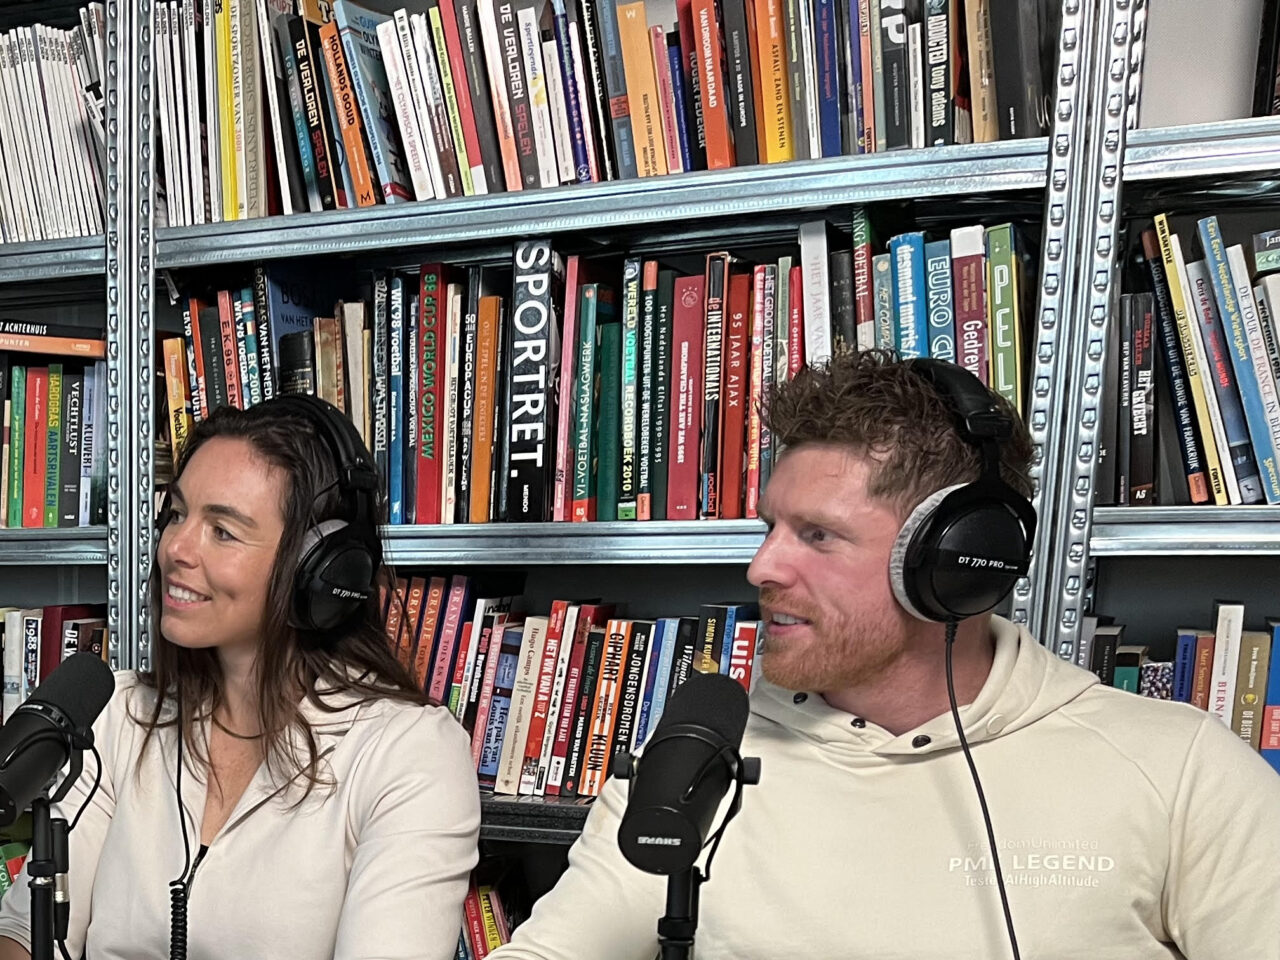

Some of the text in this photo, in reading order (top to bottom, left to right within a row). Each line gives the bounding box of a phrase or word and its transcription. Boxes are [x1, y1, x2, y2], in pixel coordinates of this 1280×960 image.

[296, 39, 308, 59] DE
[700, 8, 717, 108] VAN DROOM NAAR DAAD
[927, 14, 948, 127] ADDICTED tony adams
[299, 60, 320, 128] VERLOREN
[329, 34, 355, 126] HOLLANDS GOUD
[499, 4, 532, 156] DE VERLOREN SPELEN
[689, 52, 706, 149] ROGER FEDERER
[312, 129, 330, 179] SPELEN
[854, 243, 868, 299] VOETBAL
[391, 330, 402, 375] voetbal
[762, 275, 774, 379] HET GROOT VOETBAL
[247, 352, 260, 404] EK 2000
[421, 273, 437, 459] MEXICO WORLD CUP 86
[463, 333, 474, 418] EUROPACUP
[510, 242, 551, 478] SPORTRET.
[622, 280, 638, 491] WERELD VOETBAL RECORDBOEK 2010
[728, 313, 742, 407] 95 JAAR AJAX
[1137, 370, 1152, 389] HET
[1239, 286, 1280, 450] DE TOUR DE FRANCE IN BEELD
[70, 381, 80, 455] VECHTLUST
[576, 341, 593, 497] VI-VOETBAL-NASLAGWERK
[639, 295, 653, 489] 100 HOOGTEPUNTEN UIT DE WERELDBEKER VOETBAL
[1132, 389, 1148, 436] GEVECHT
[46, 373, 59, 507] HARDGRAS AARTSRIVALEN
[1211, 468, 1222, 494] FONTEIN
[1263, 457, 1279, 497] Spectrum
[958, 556, 1004, 569] DT 770 PRO
[26, 623, 38, 650] 1988
[523, 627, 539, 676] Hugo Camps
[602, 633, 625, 684] GIPHART
[702, 618, 716, 668] SIMON KUPER
[729, 622, 757, 681] Luis
[617, 653, 642, 742] JONGENSDROMEN
[1197, 648, 1209, 691] Mart Smeets
[480, 700, 501, 768] Louis van Gaal
[490, 706, 508, 763] Het pak van
[587, 734, 608, 772] KLUUN
[636, 836, 682, 846] SHURE
[1012, 854, 1115, 872] LEGEND
